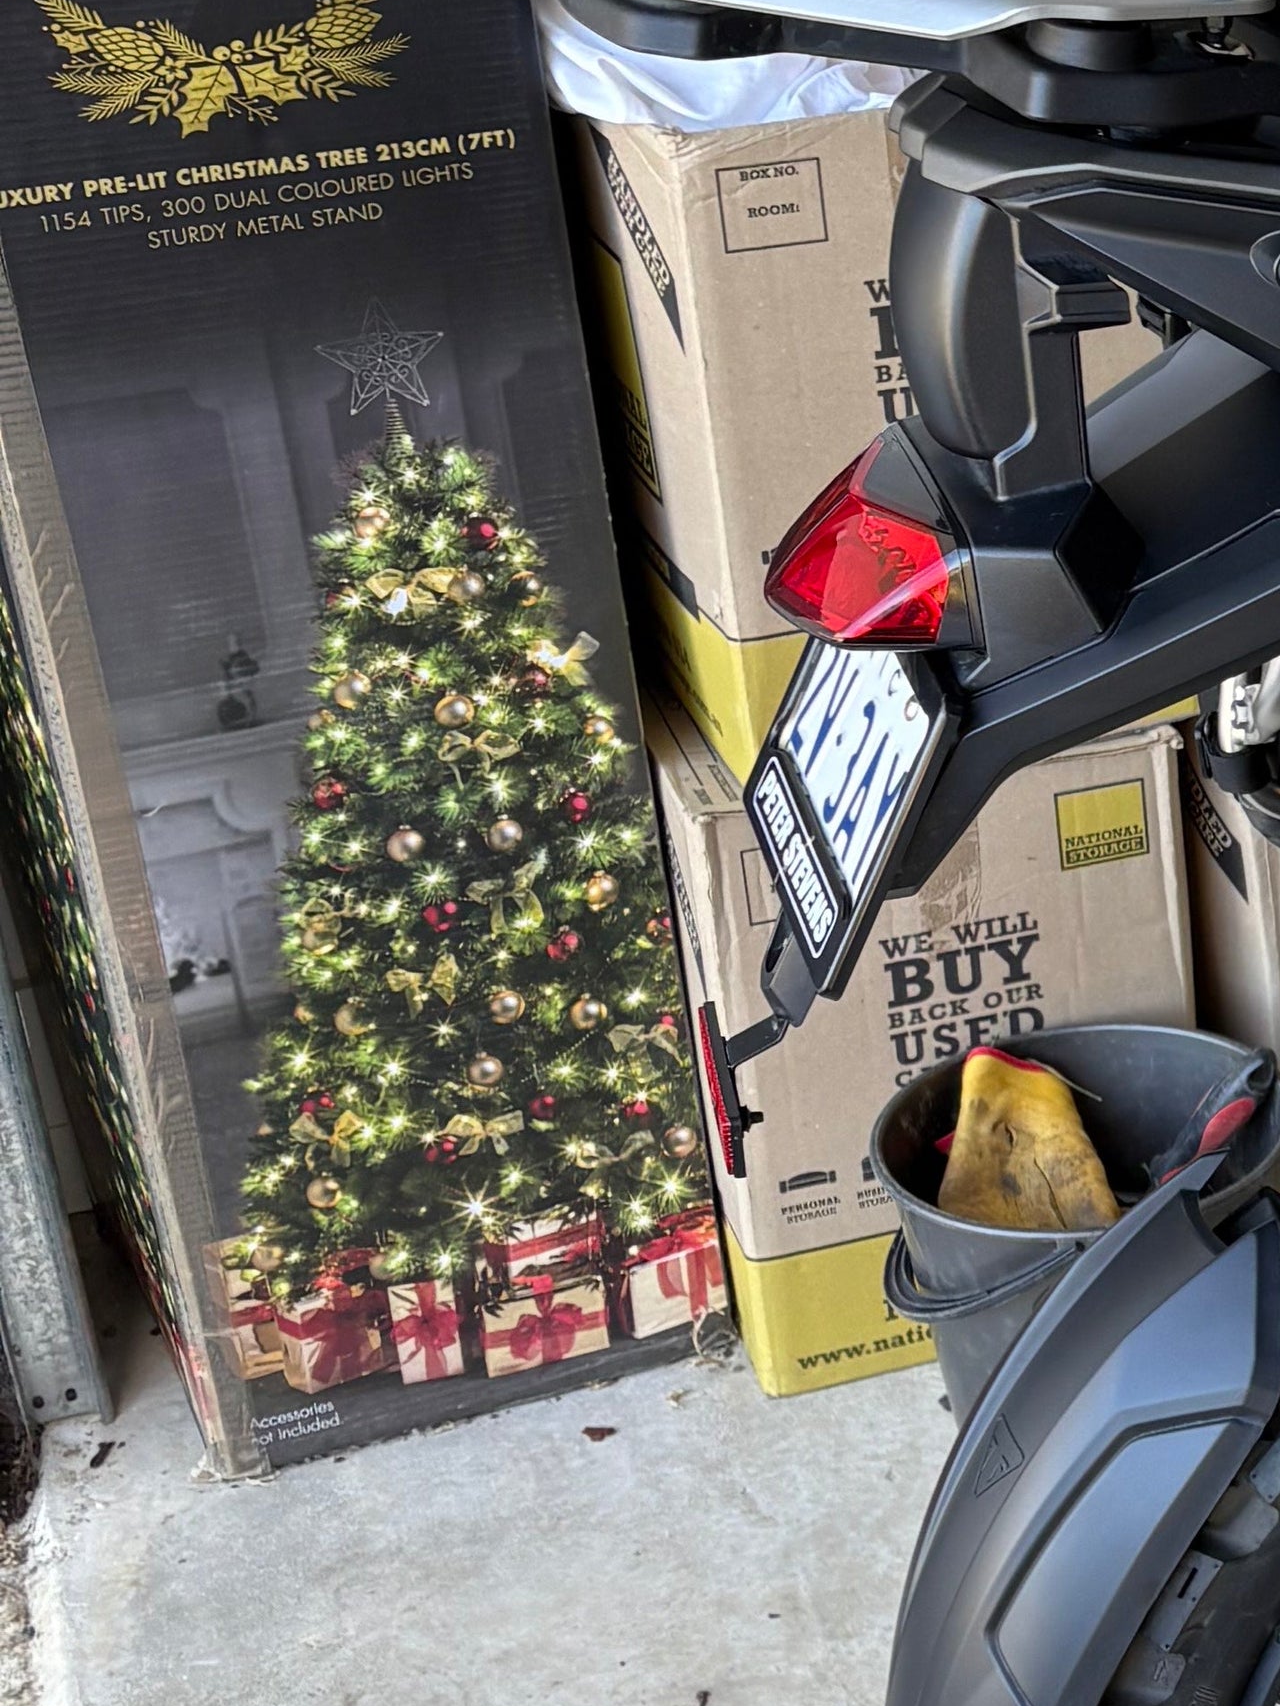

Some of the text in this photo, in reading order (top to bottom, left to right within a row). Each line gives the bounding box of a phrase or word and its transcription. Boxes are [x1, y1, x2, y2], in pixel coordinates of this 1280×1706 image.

[83, 171, 168, 199] PRE-LIT
[175, 153, 311, 187] CHRISTMAS
[315, 147, 369, 170] TREE
[374, 136, 452, 163] 213CM
[457, 129, 517, 157] (7FT)
[739, 165, 800, 182] BOX NO.
[40, 162, 475, 234] 1154 TIPS, 300 DUAL COLOURED LIGHTS
[147, 202, 385, 250] STURDY METAL STAND
[757, 769, 833, 944] PETER STEVENS
[1064, 824, 1144, 850] NATIONAL
[1066, 837, 1144, 863] STORAGE
[879, 911, 1038, 960] WE WILL
[884, 932, 1040, 1009] BUY
[887, 982, 1044, 1031] BACK OUR
[890, 1006, 1045, 1066] USED
[250, 1401, 335, 1429] Accessories
